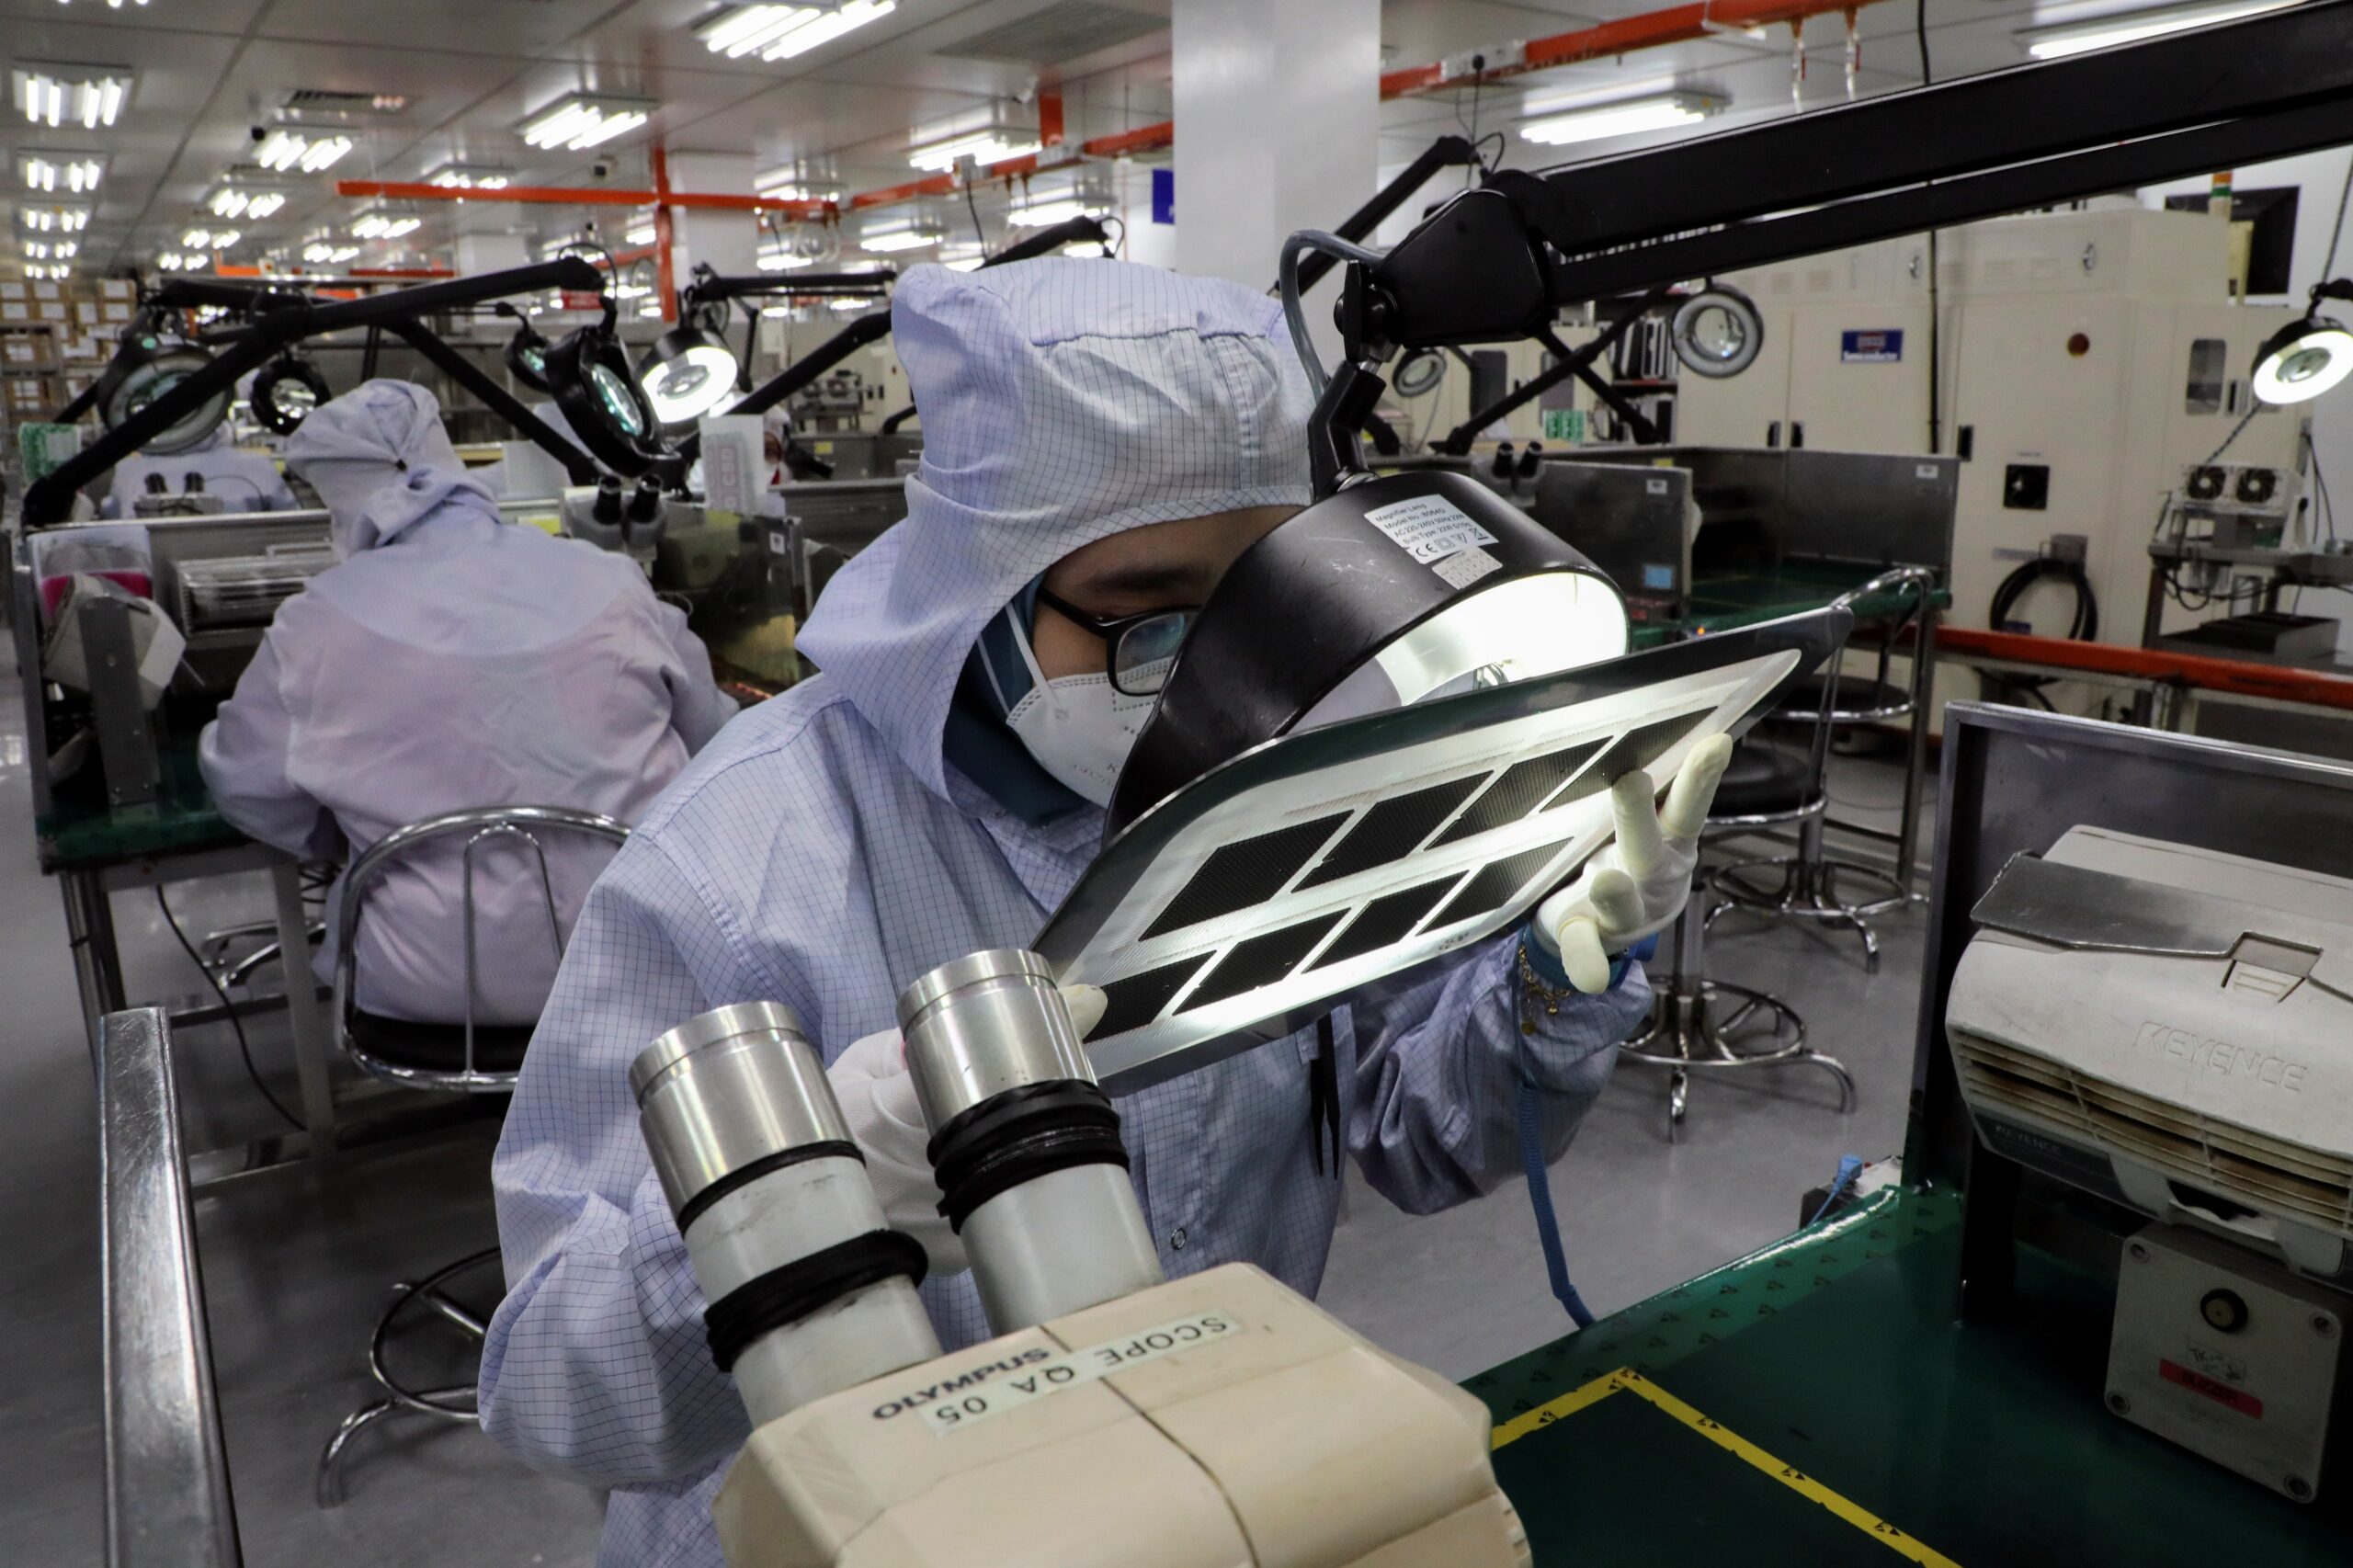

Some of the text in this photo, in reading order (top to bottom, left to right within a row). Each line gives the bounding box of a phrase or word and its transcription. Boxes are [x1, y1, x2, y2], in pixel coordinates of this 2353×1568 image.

[2132, 1020, 2309, 1093] KEYENCE
[871, 1346, 1051, 1421] OLYMPUS
[936, 1316, 1228, 1424] SCOPE QA 05
